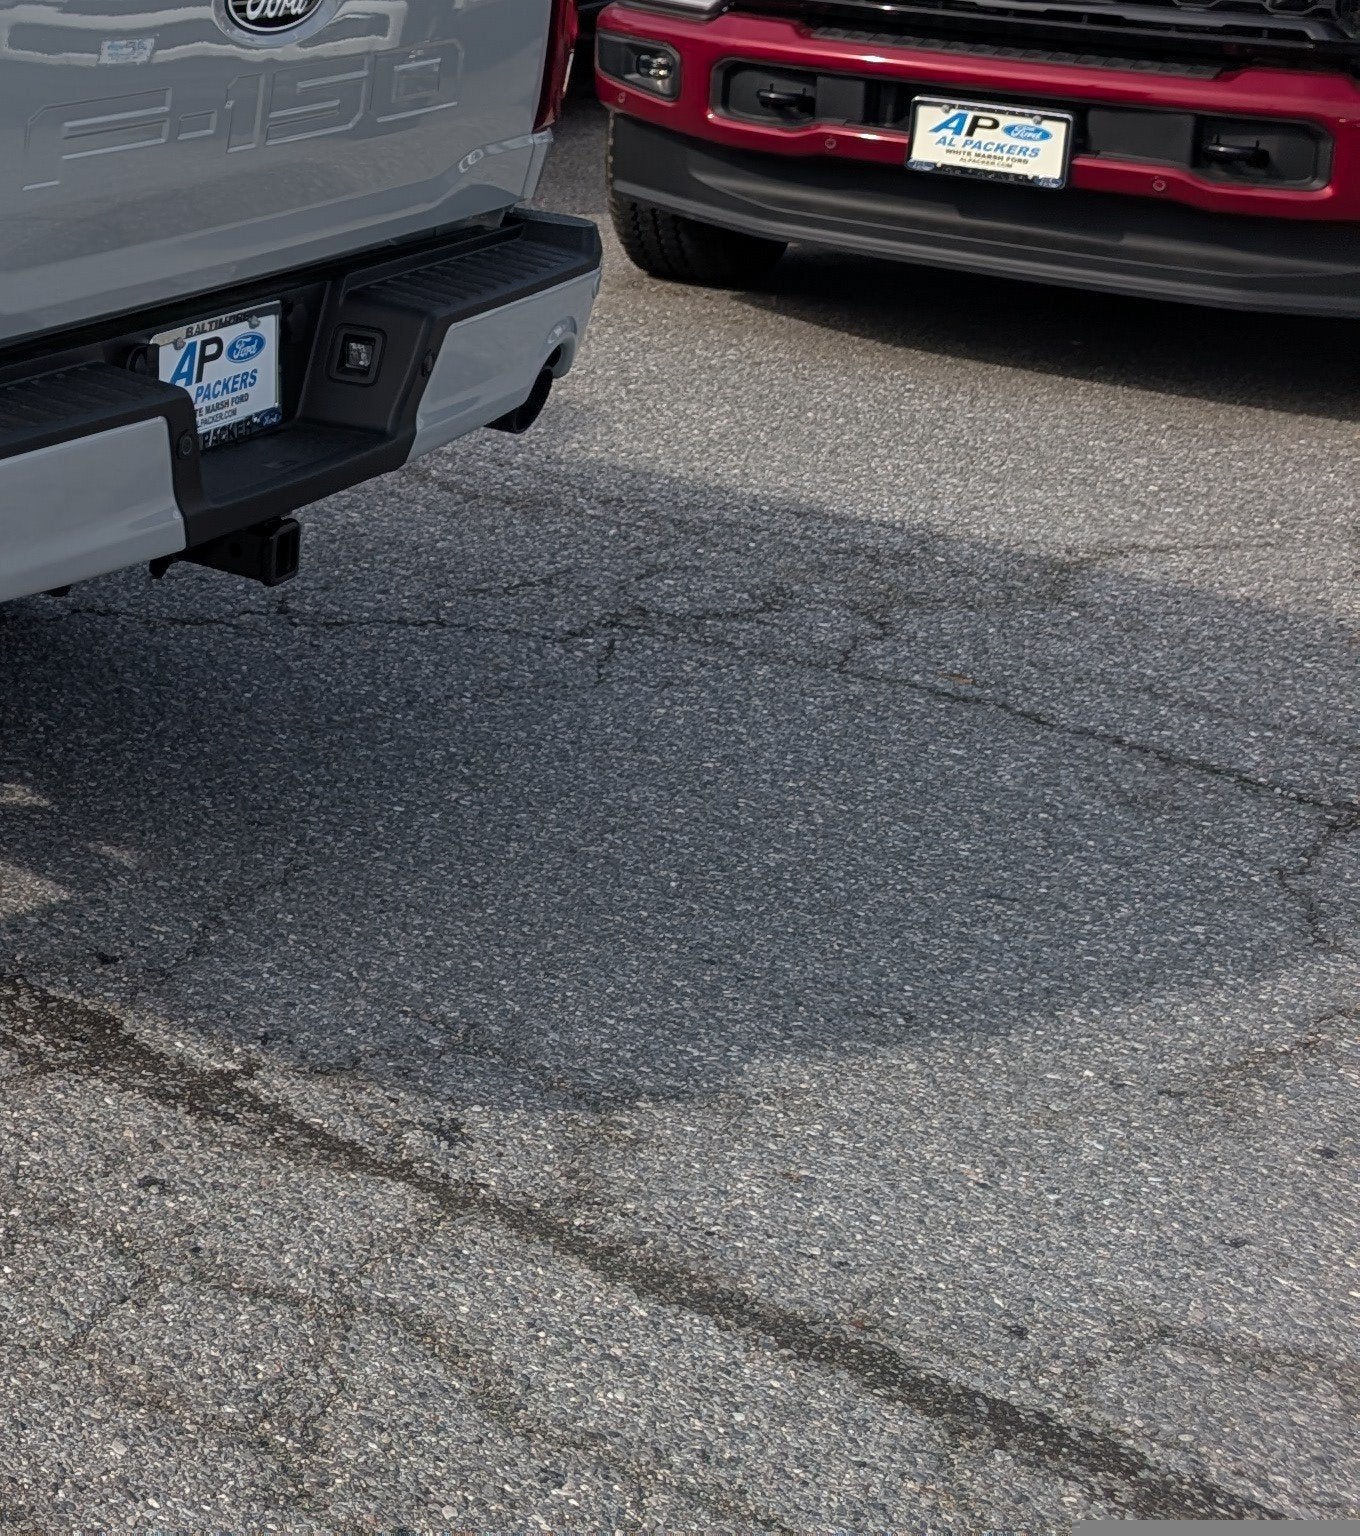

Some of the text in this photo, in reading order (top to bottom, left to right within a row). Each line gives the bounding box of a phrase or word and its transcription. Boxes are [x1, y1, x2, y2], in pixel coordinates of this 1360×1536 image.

[928, 110, 1000, 138] AP
[935, 135, 1042, 159] AL PACKERS
[945, 148, 1029, 165] WHITE MARSH FORD
[169, 336, 224, 388] AP
[194, 368, 258, 404] PACKERS
[204, 399, 230, 414] MARSH
[230, 393, 250, 408] FORD
